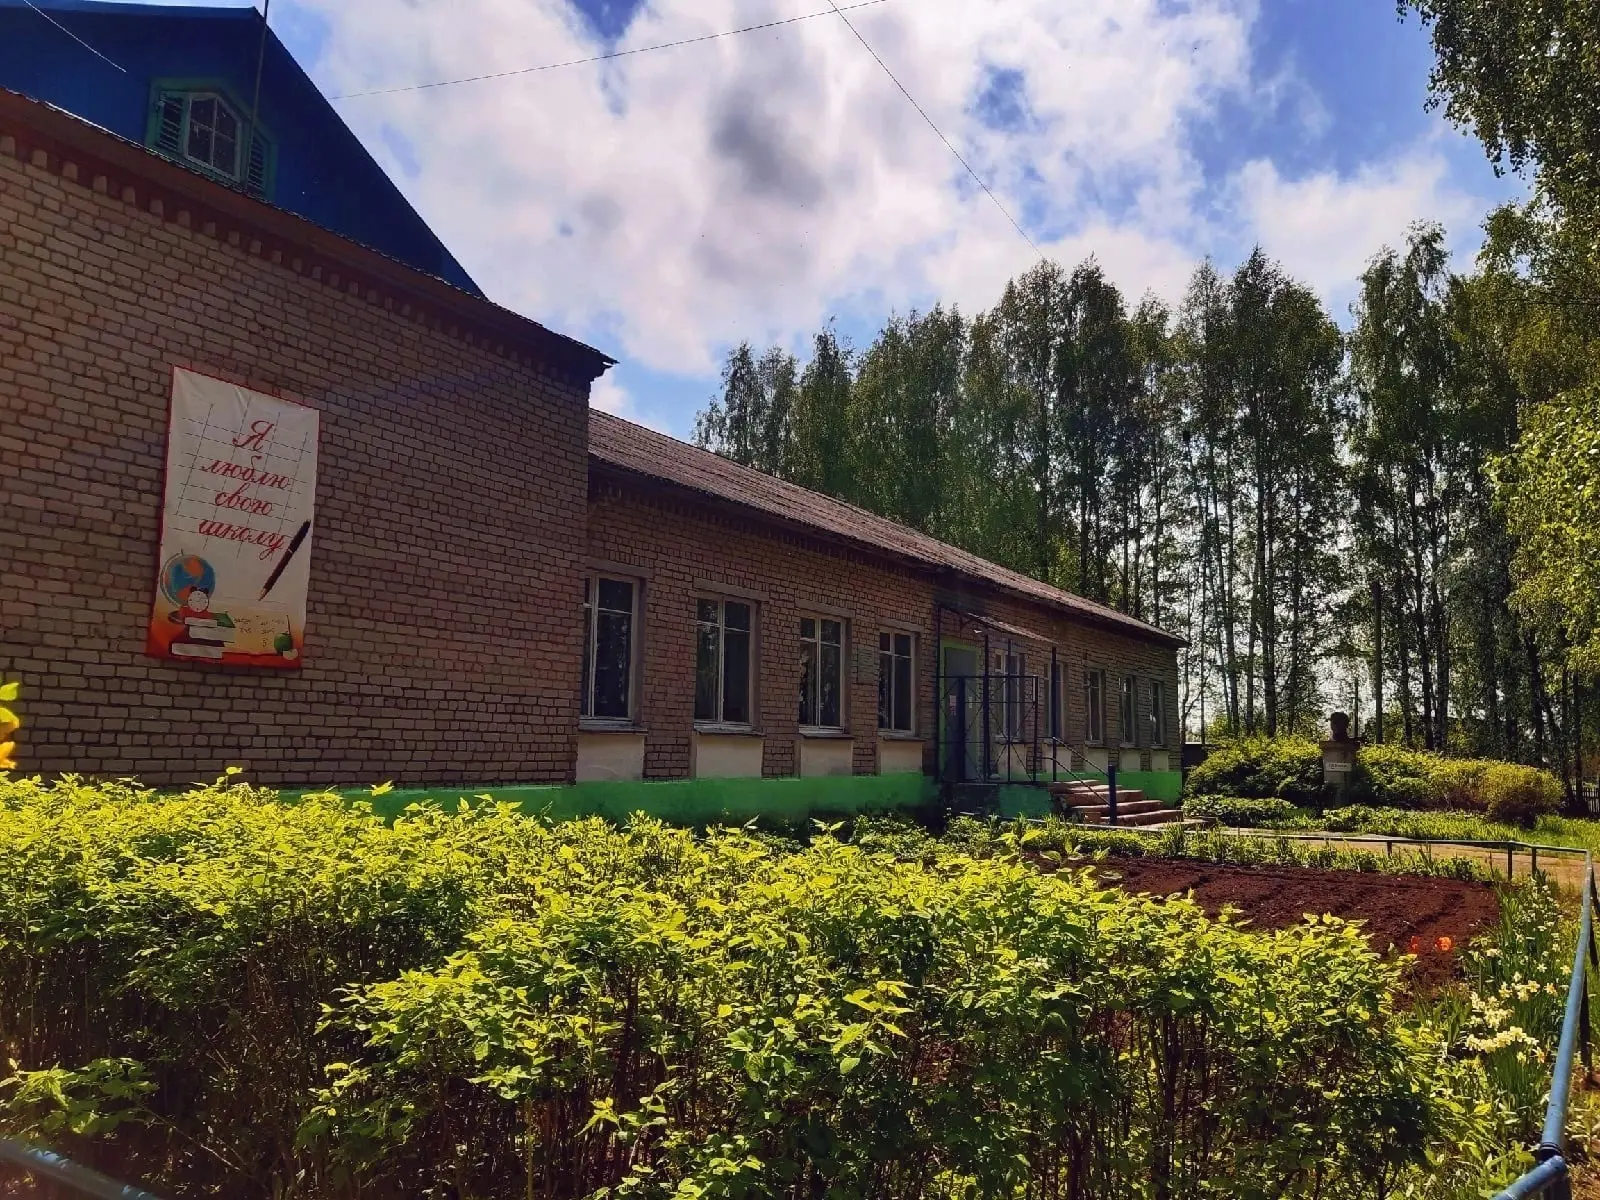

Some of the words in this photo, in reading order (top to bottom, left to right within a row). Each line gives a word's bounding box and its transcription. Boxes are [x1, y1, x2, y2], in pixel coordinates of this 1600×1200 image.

[232, 420, 273, 452] Я
[201, 455, 291, 489] люблю
[215, 483, 272, 515] свою
[199, 520, 284, 560] школу
